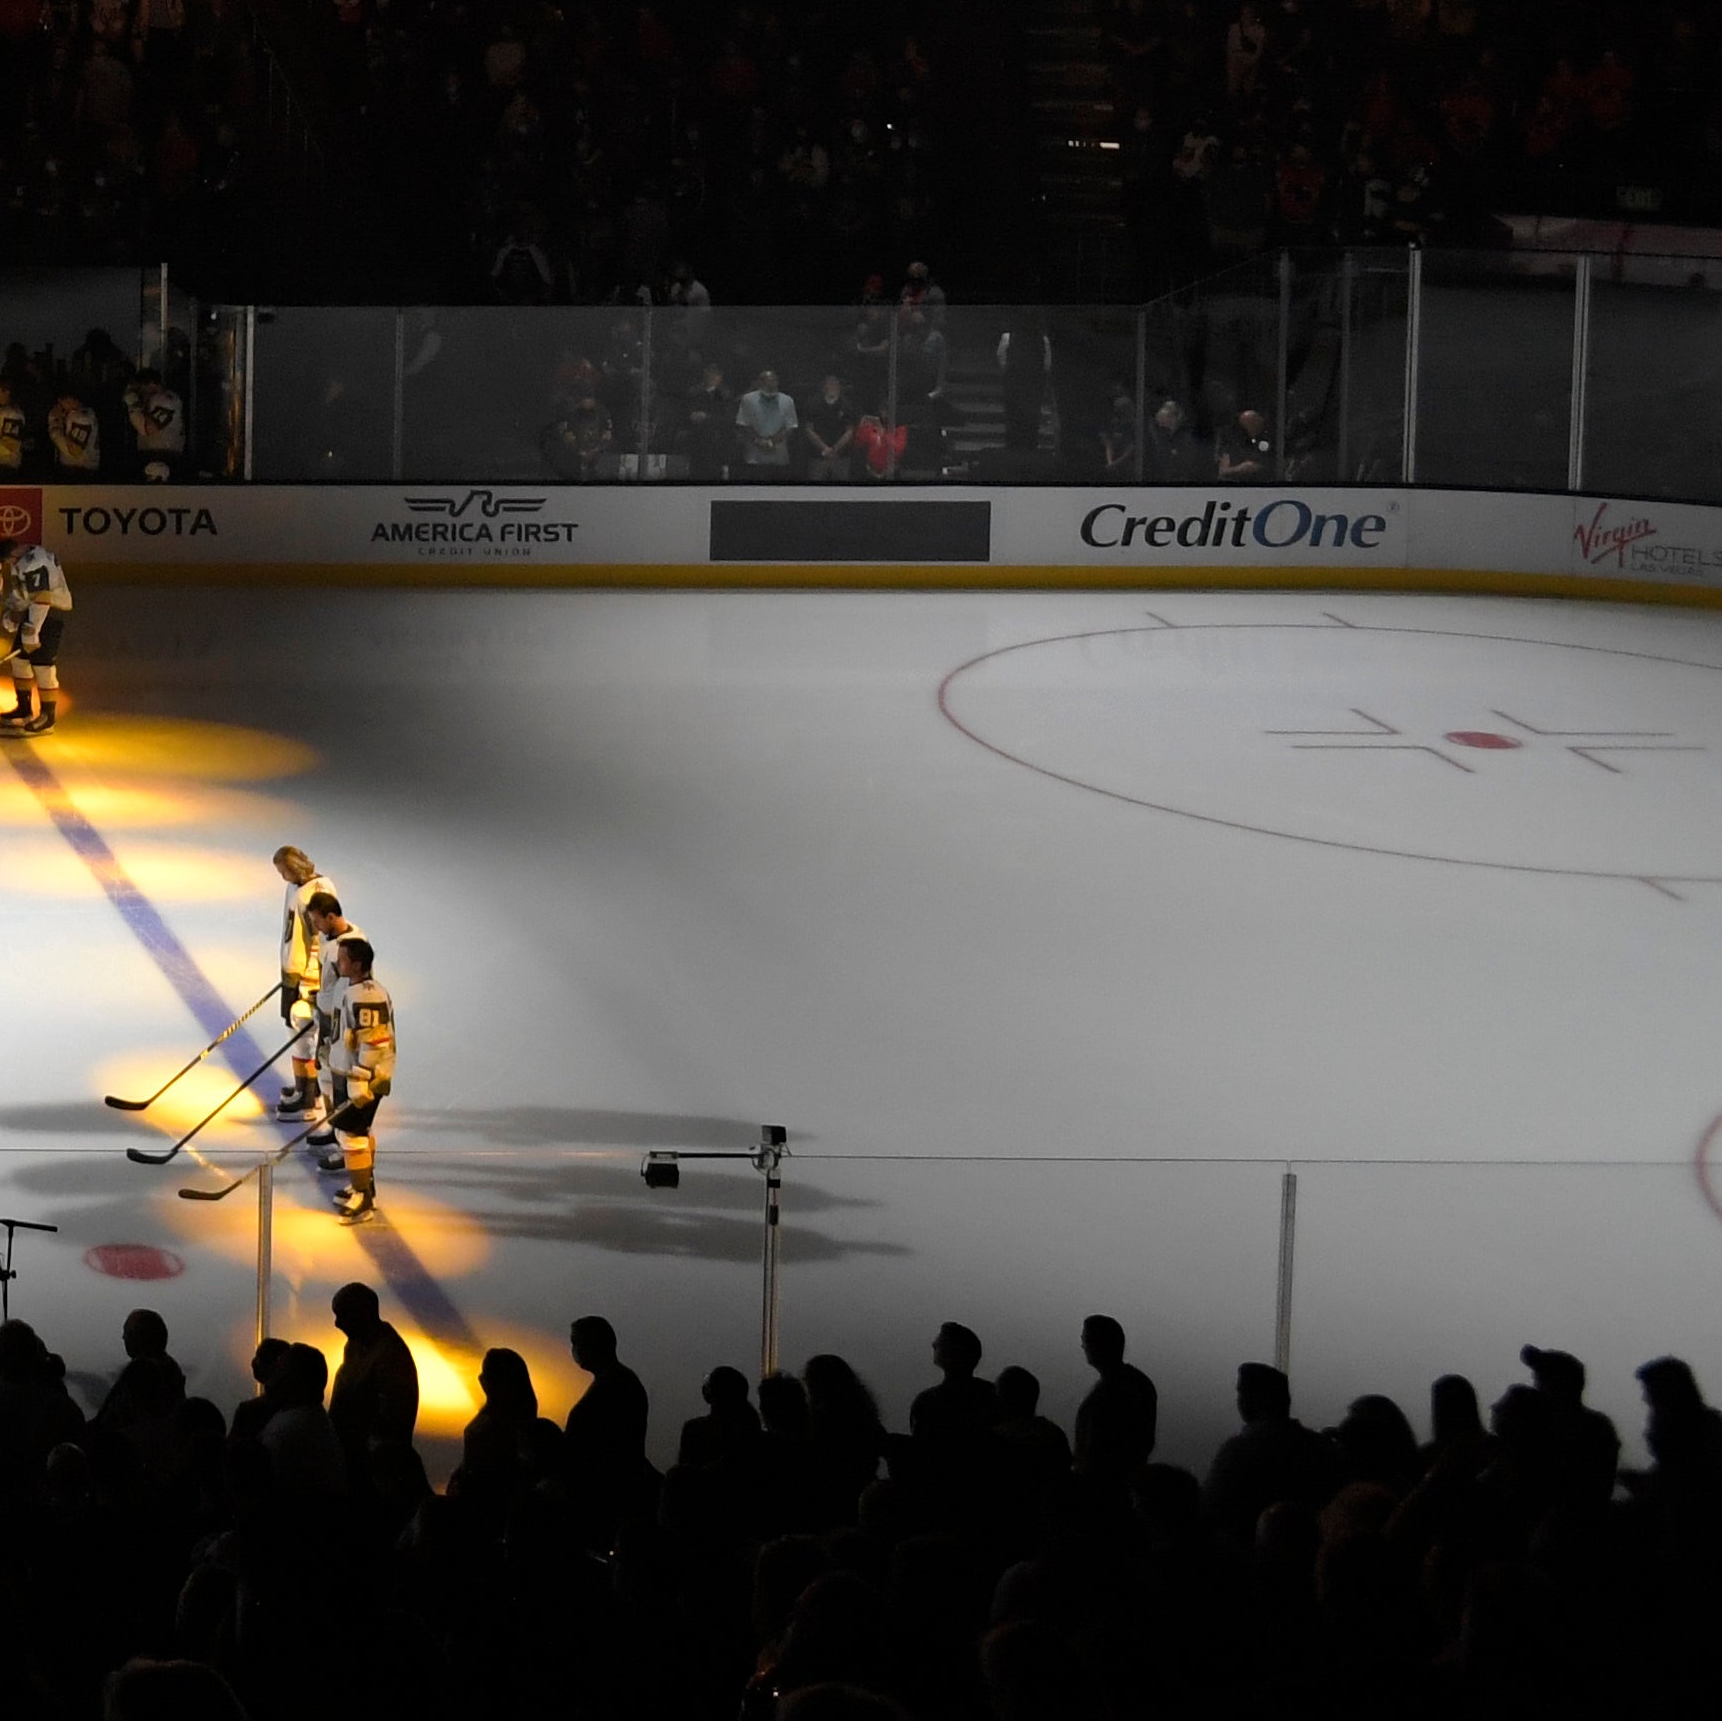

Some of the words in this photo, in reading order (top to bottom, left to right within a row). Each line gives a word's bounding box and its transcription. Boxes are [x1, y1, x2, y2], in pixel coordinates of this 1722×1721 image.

[59, 507, 218, 536] TOYOTA
[371, 523, 494, 543] AMERICA
[499, 522, 579, 543] FIRST
[32, 573, 41, 587] 7
[358, 1008, 381, 1028] 81
